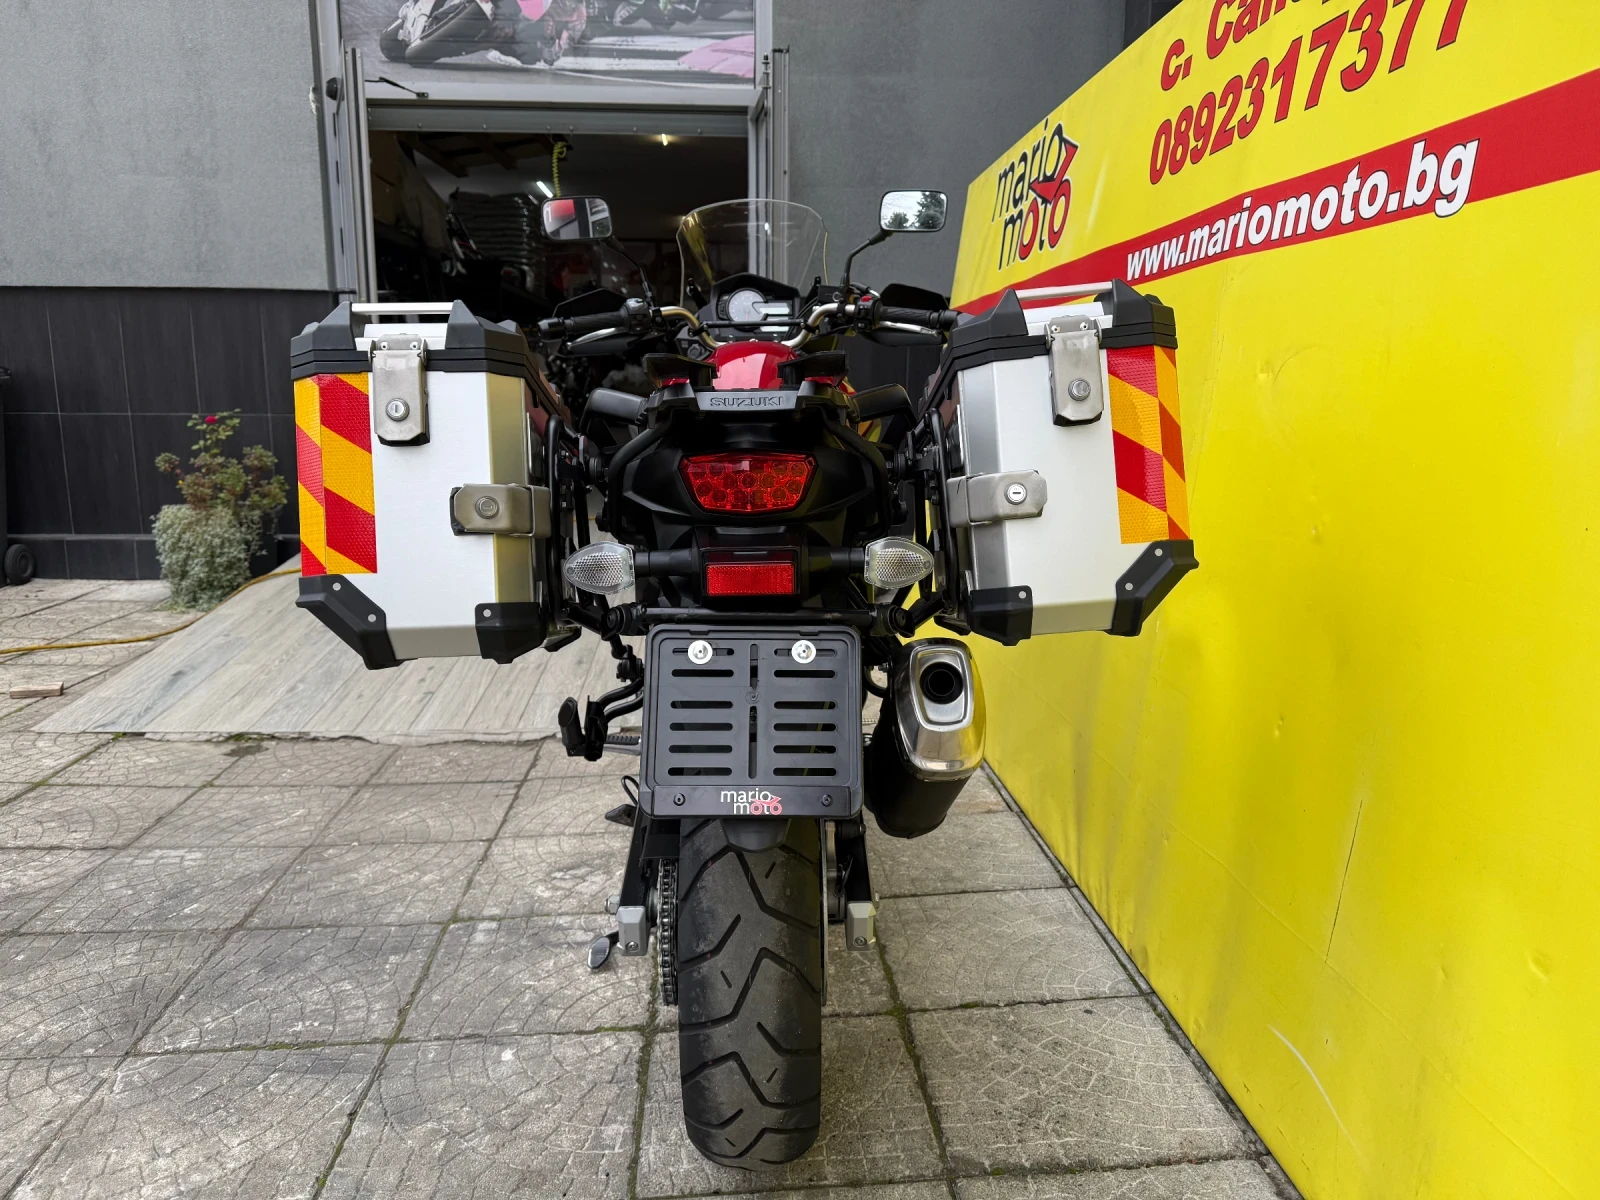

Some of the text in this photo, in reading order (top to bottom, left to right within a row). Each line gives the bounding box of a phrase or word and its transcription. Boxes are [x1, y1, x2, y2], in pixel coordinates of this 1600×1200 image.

[992, 117, 1064, 223] mario
[998, 177, 1072, 270] moto
[1125, 138, 1480, 281] www.mariomoto.bg
[709, 395, 784, 408] SUZUKI
[720, 787, 772, 803] mario
[733, 801, 783, 816] moto
